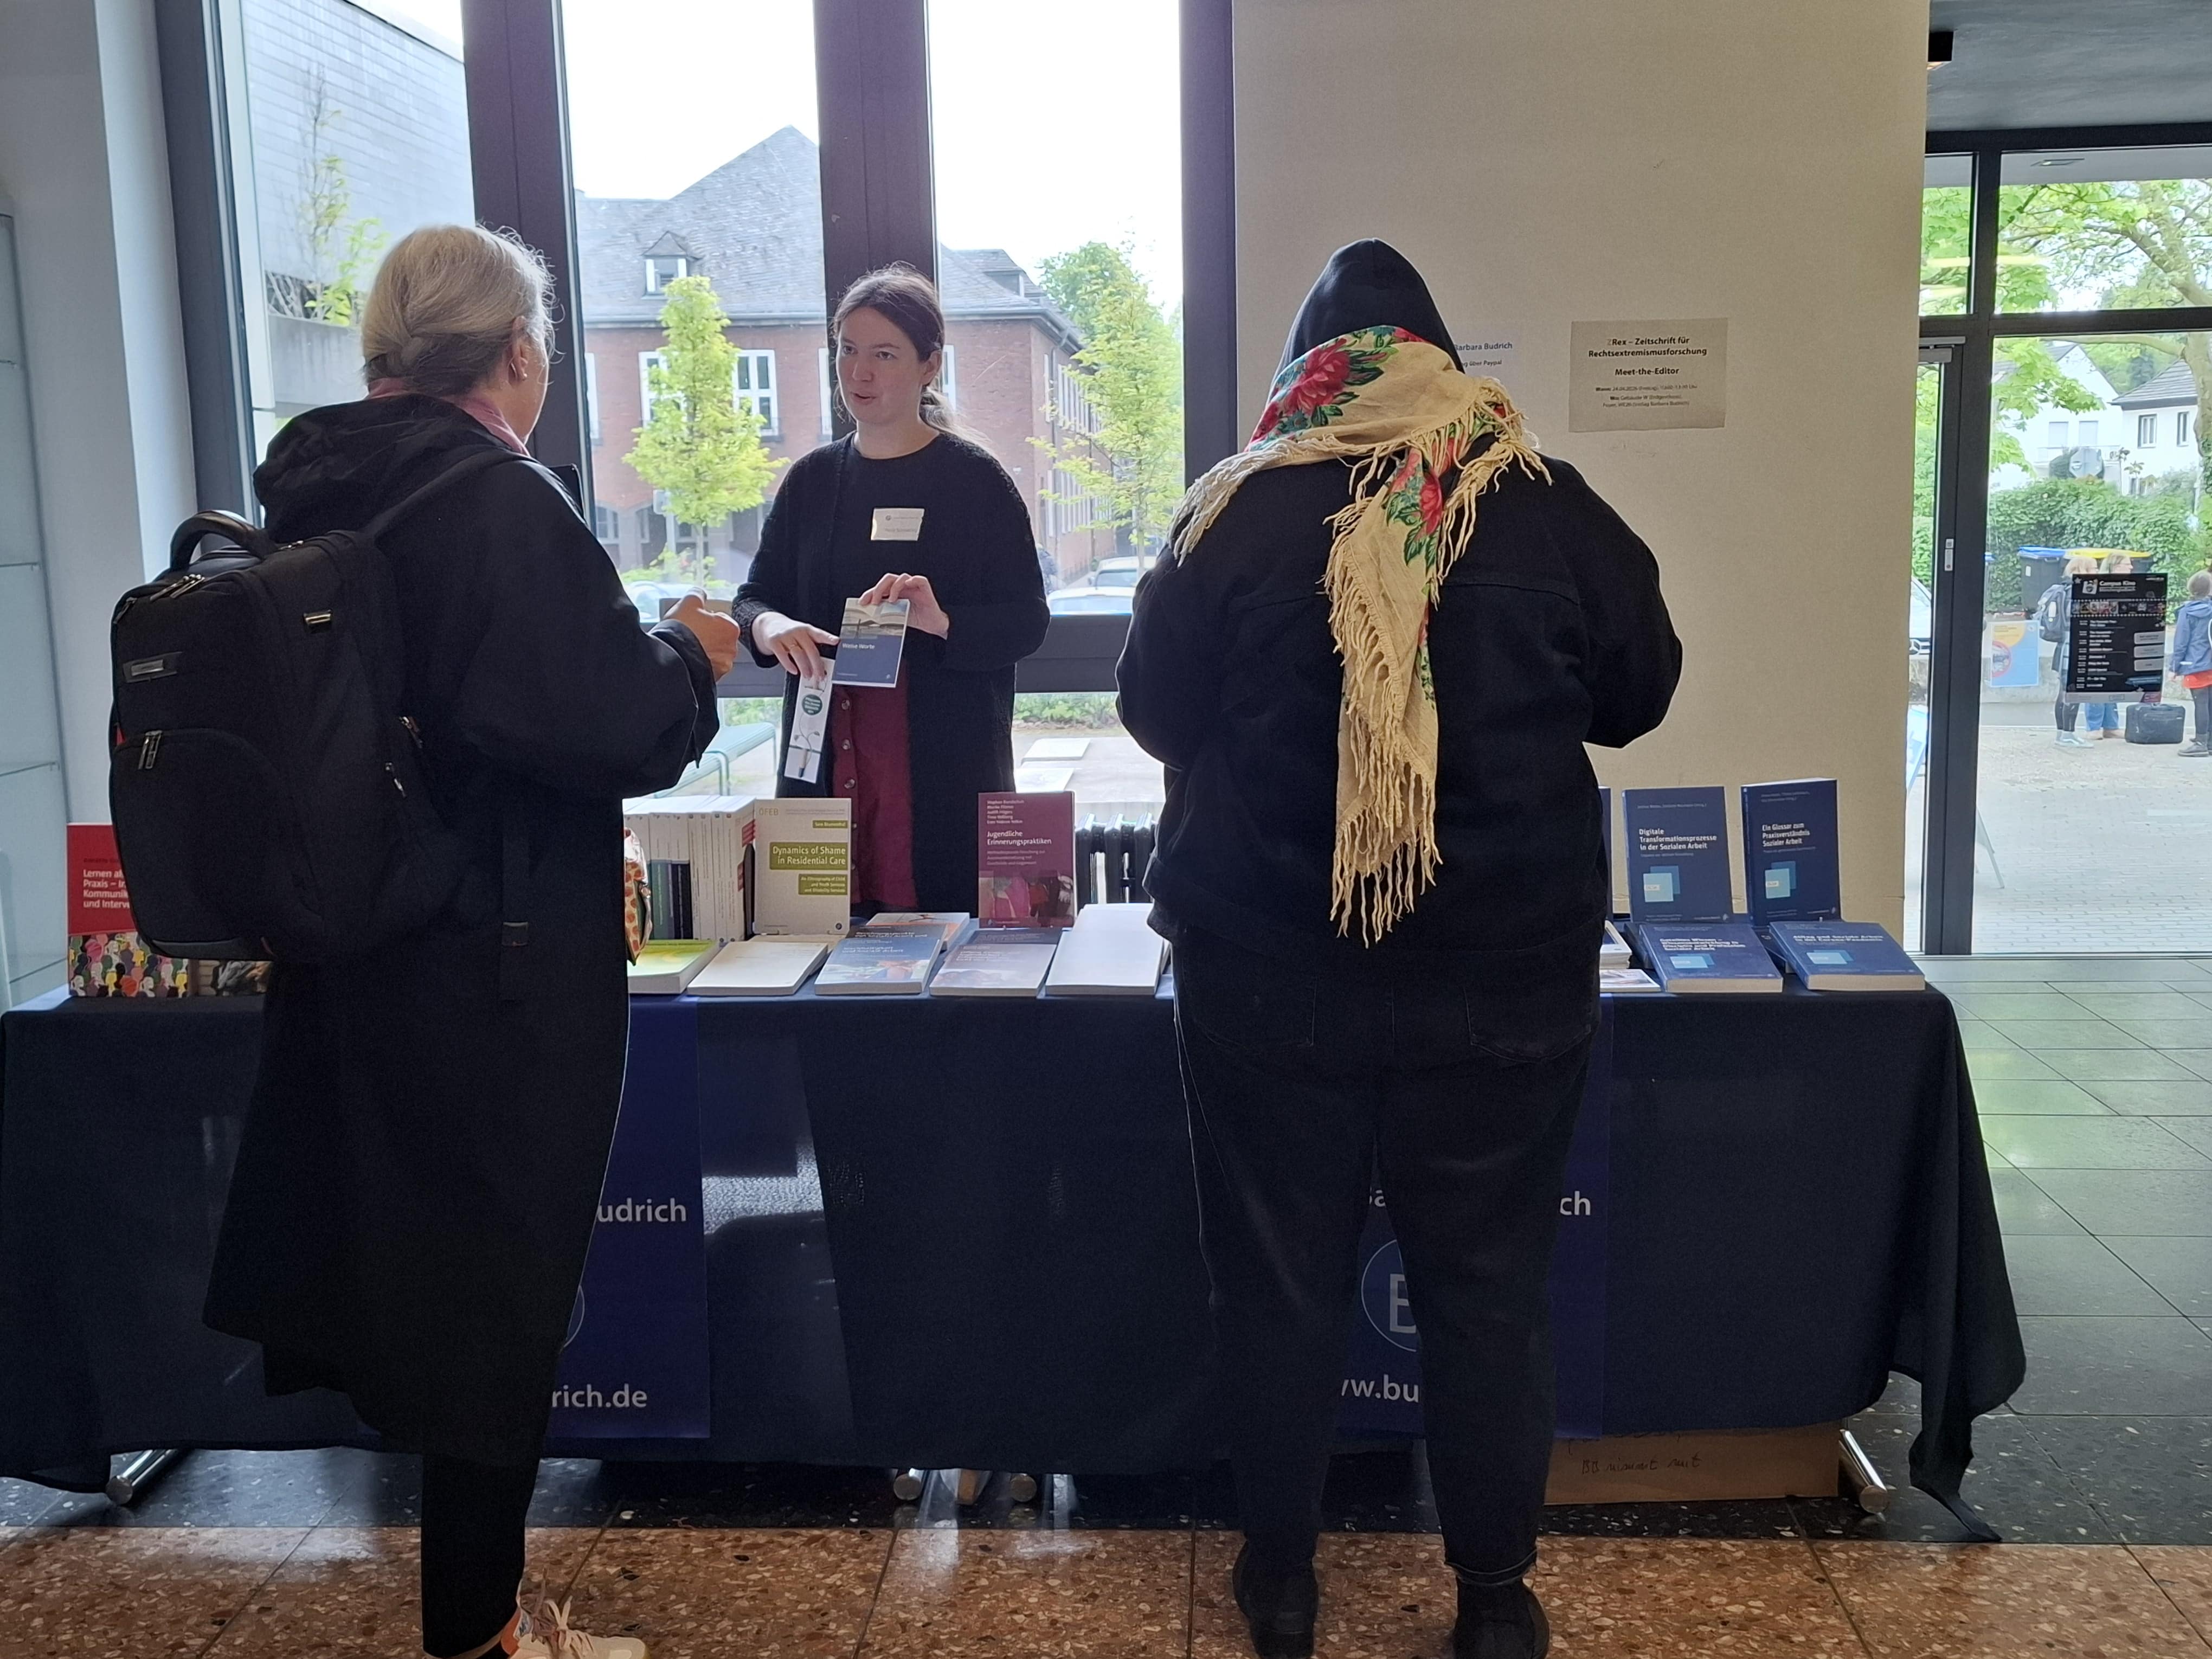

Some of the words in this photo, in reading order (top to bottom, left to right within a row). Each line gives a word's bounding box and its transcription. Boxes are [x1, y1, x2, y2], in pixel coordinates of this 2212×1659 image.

[1635, 337, 1676, 345] Zeitschrift
[1677, 336, 1690, 344] für
[1484, 342, 1513, 350] Budrich
[1589, 348, 1707, 357] Rechtsextremismusforschung
[1615, 367, 1680, 376] Meet-the-Editor
[987, 831, 1023, 839] Jugendliche
[773, 846, 809, 855] Dynamics
[820, 846, 846, 854] Shame
[83, 869, 112, 878] Lernen
[114, 869, 124, 878] al
[83, 879, 108, 888] Praxis
